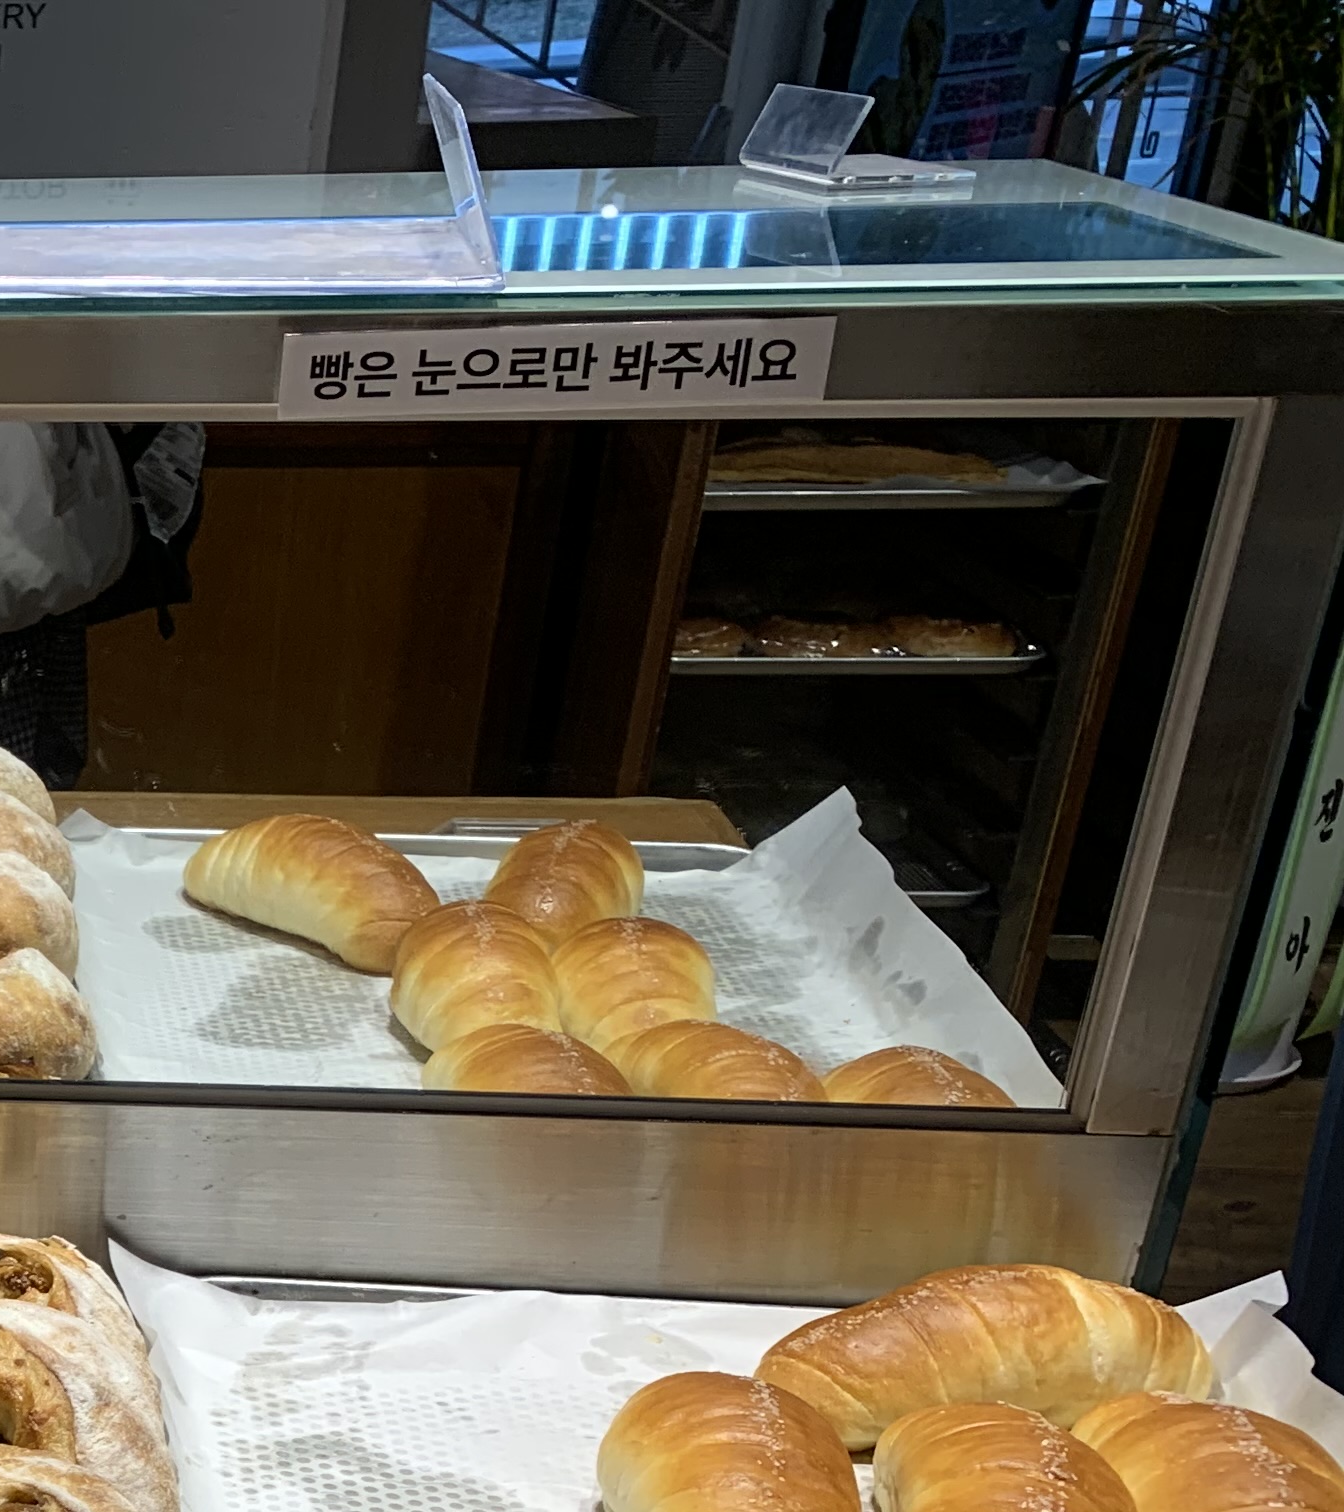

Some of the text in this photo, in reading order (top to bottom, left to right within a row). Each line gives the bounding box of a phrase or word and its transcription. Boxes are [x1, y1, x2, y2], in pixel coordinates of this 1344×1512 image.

[311, 337, 797, 399] 빵은 눈으로만 봐주세요
